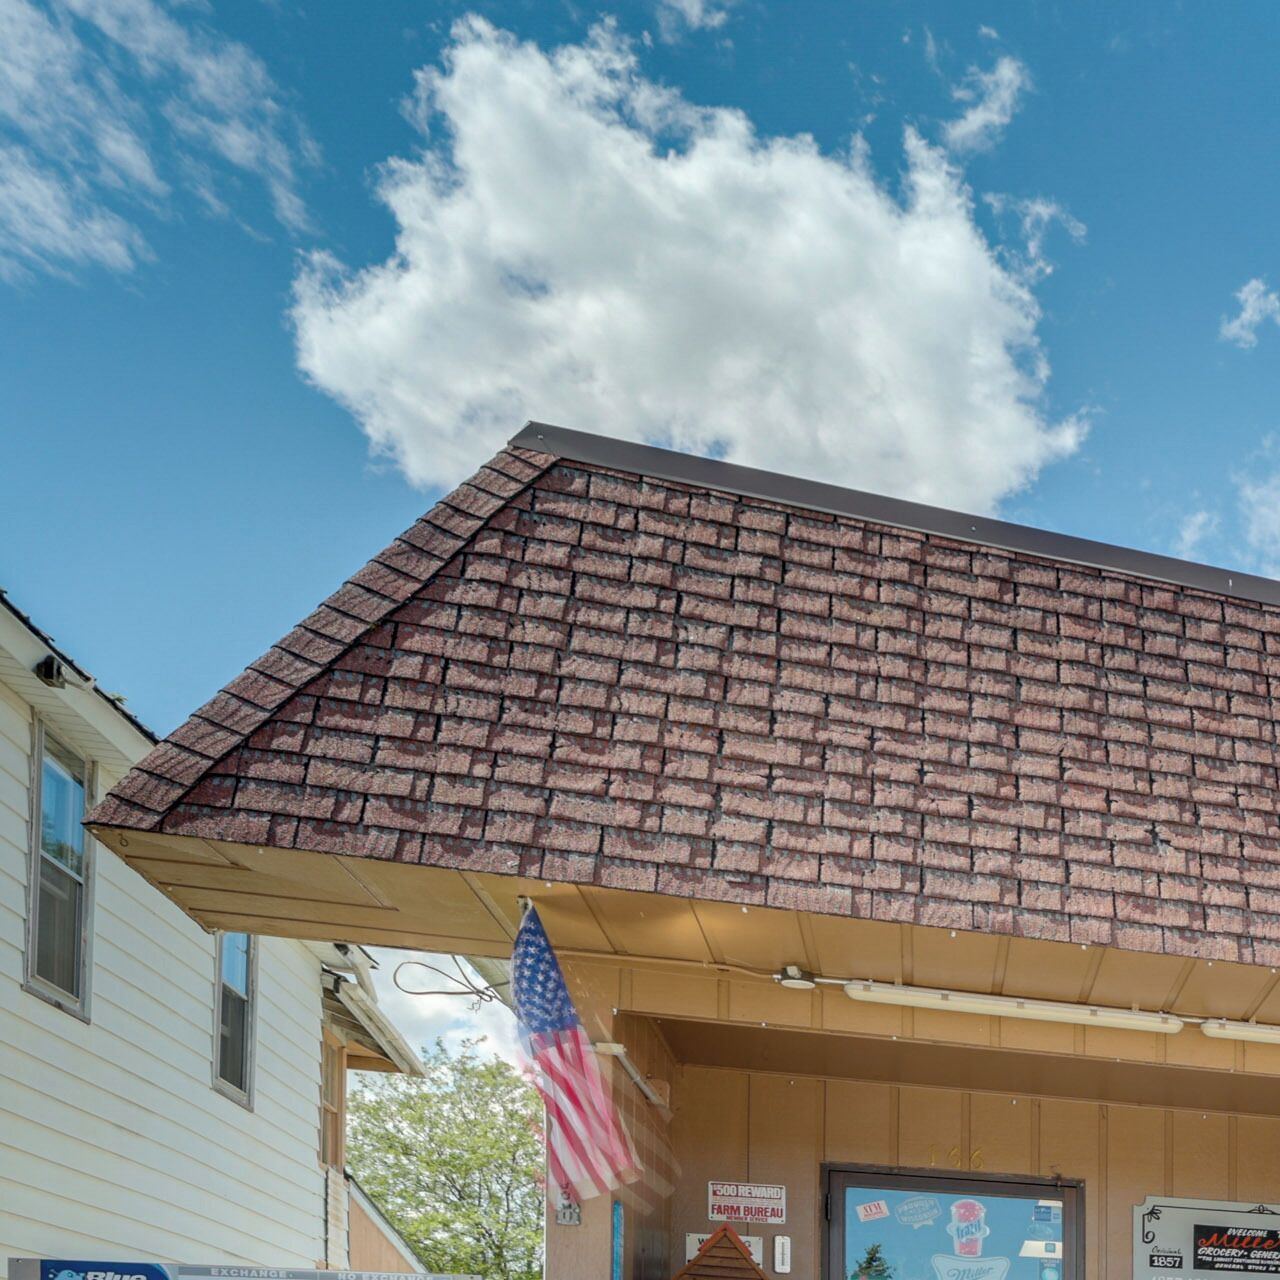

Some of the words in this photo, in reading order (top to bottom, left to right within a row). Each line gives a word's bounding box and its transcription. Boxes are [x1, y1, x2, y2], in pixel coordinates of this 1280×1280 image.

[738, 1185, 781, 1199] REWARD
[711, 1204, 740, 1216] FARM
[743, 1206, 783, 1218] BUREAU
[1198, 1247, 1243, 1257] GROCERY
[1152, 1256, 1181, 1267] 1857
[338, 1273, 357, 1280] NO
